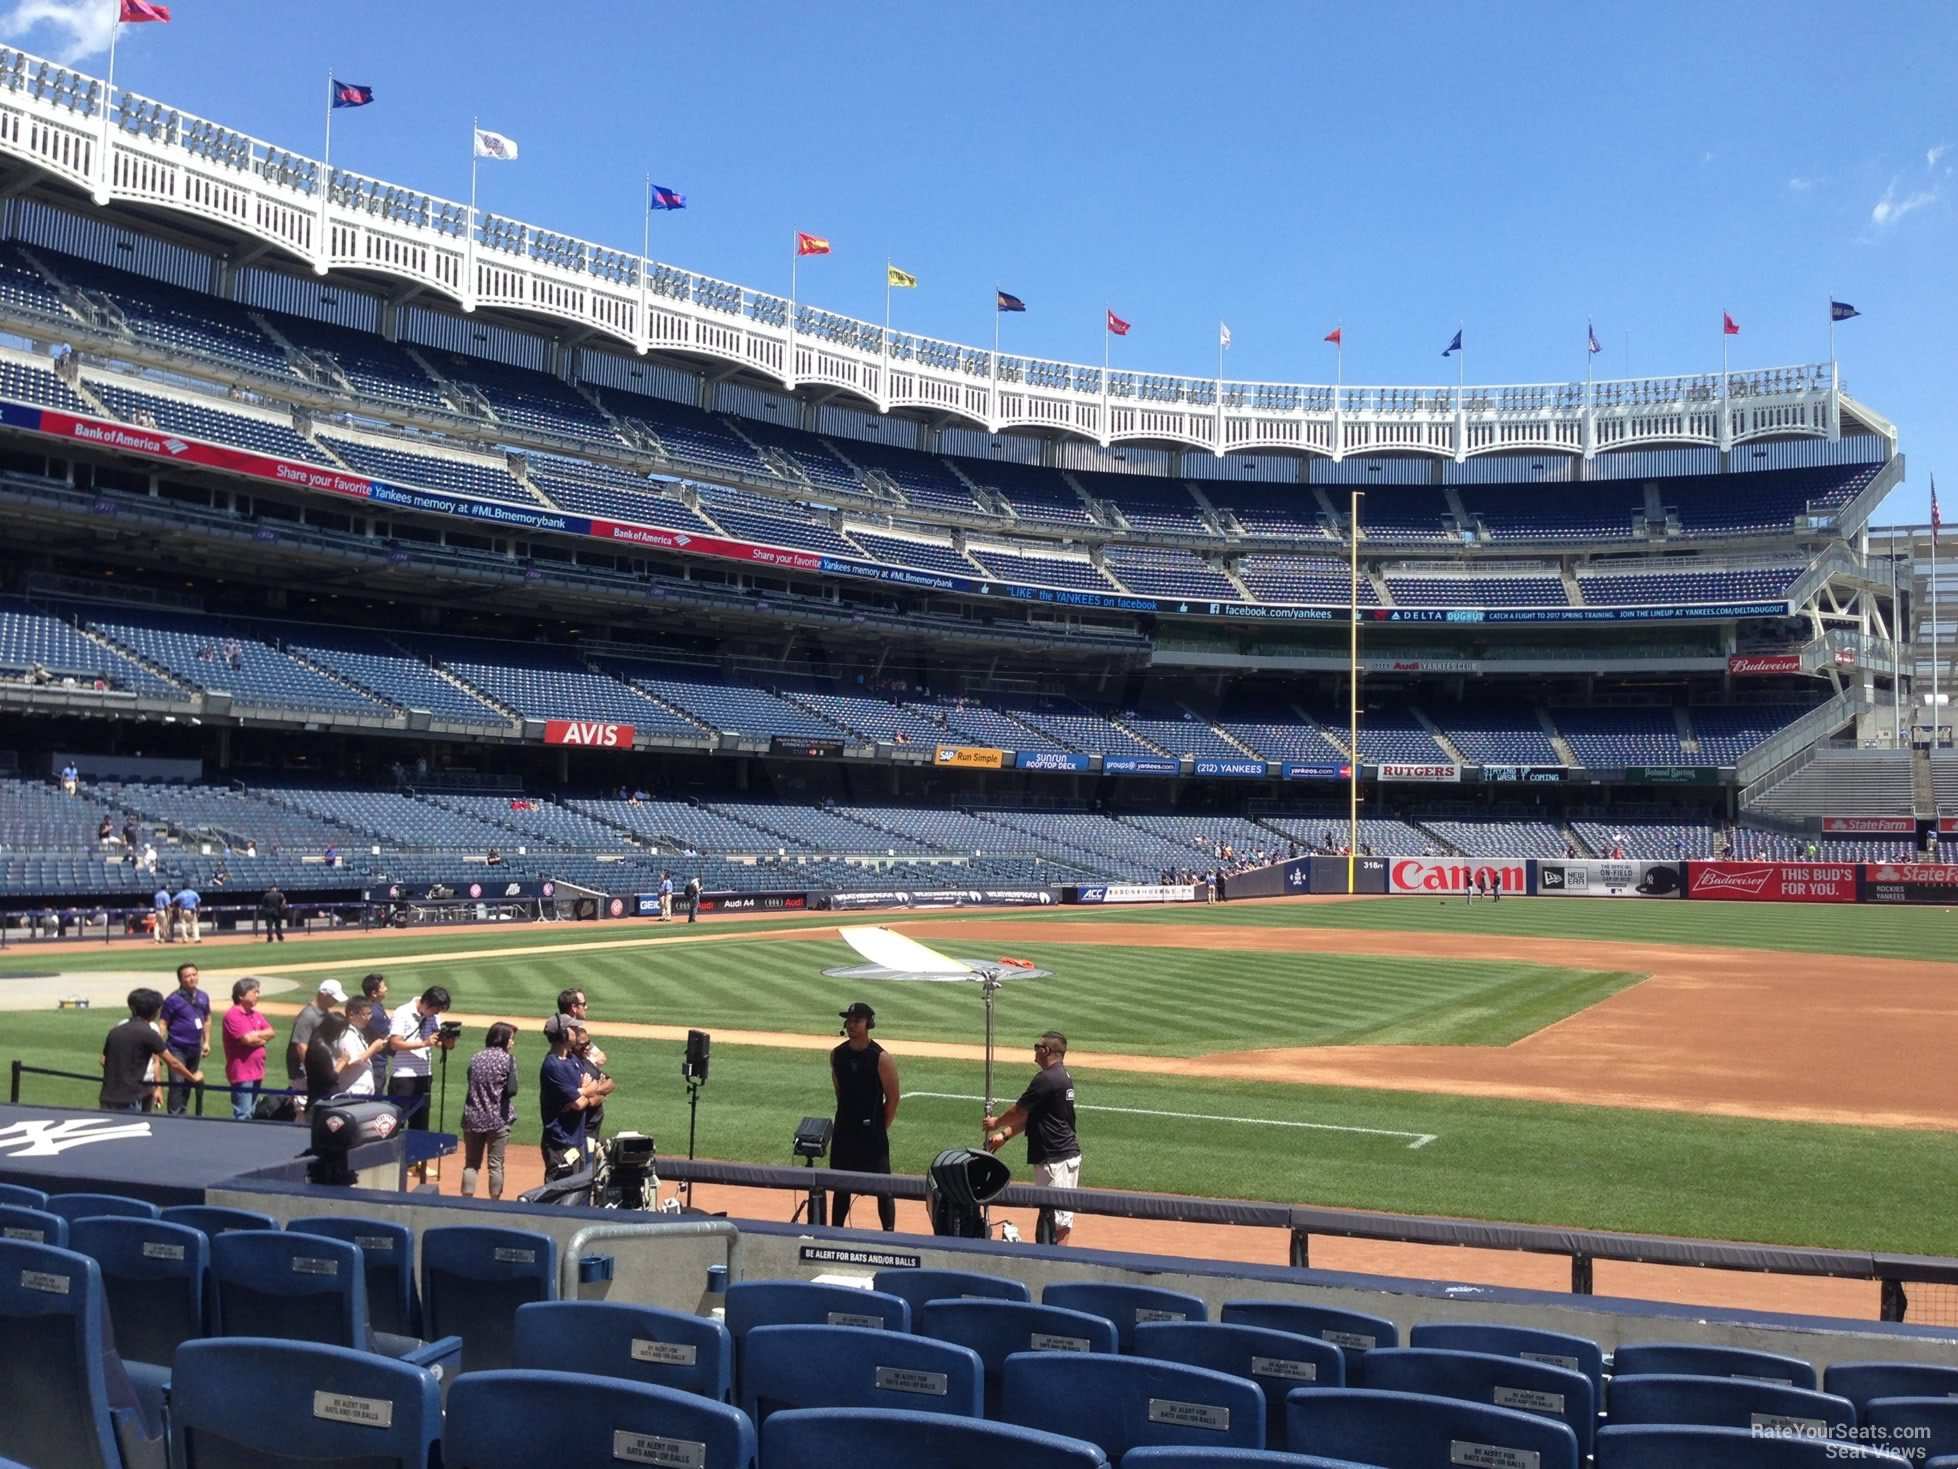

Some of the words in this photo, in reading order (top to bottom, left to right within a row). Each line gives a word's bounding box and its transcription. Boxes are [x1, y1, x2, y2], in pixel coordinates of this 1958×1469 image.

[74, 422, 104, 440] Bank
[104, 431, 116, 442] of
[116, 434, 160, 452] America
[276, 464, 307, 481] Share
[308, 473, 332, 486] your
[335, 477, 372, 496] favorite
[375, 485, 412, 504] Yankees
[414, 497, 455, 513] memory
[458, 503, 468, 514] at
[472, 505, 566, 529] #MLBmemorybank
[614, 528, 633, 540] Bank
[633, 532, 642, 541] of
[642, 532, 672, 545] America
[753, 549, 775, 561] Share
[775, 554, 793, 564] your
[794, 554, 822, 568] favorite
[823, 558, 851, 573] Yankees
[852, 566, 879, 579] memory
[881, 570, 888, 578] at
[890, 571, 953, 588] #MLBmemorybank
[1039, 590, 1052, 601] the
[1056, 593, 1100, 606] YANKEES
[1103, 598, 1114, 607] on
[1117, 597, 1157, 610] facebook
[1225, 604, 1332, 619] facebook.com/yankees
[1404, 611, 1442, 620] DELTA
[1489, 612, 1508, 620] CATCH
[1561, 611, 1583, 619] SPRING
[1585, 611, 1616, 619] TRAINING.
[1619, 610, 1635, 618] JOIN
[1636, 610, 1649, 618] THE
[1650, 609, 1674, 617] LINEUP
[1685, 605, 1784, 616] YANKEES.COM/DELTADUGOUT
[1394, 662, 1419, 670] Audi
[1422, 662, 1456, 670] YANKEES
[1730, 659, 1800, 673] Budweiser
[562, 723, 619, 746] AVIS
[939, 750, 955, 761] SAP
[957, 753, 971, 761] Run
[973, 753, 997, 764] Simple
[1026, 761, 1057, 769] ROOFTOP
[1058, 762, 1076, 770] DECK
[1197, 764, 1218, 774] (212)
[1220, 764, 1262, 774] YANKEES
[1290, 767, 1334, 776] yankees.com
[1383, 766, 1456, 777] RUTGERS
[1483, 767, 1516, 775] STAYING
[1644, 768, 1670, 777] Poland
[1671, 768, 1696, 779] Spring
[1392, 860, 1524, 891] Canon
[1700, 873, 1764, 886] Budweiser
[1781, 868, 1810, 881] THIS
[1814, 869, 1853, 881] BUD'S
[1083, 889, 1103, 898] ACC
[1781, 883, 1806, 895] FOR
[1809, 883, 1840, 895] YOU.
[640, 901, 661, 910] GEIC
[724, 900, 742, 908] Audi
[743, 899, 755, 907] A4
[785, 899, 804, 907] Audi
[805, 1249, 814, 1258] BE
[815, 1250, 835, 1259] ALERT
[836, 1252, 849, 1260] FOR
[850, 1253, 867, 1263] BATS
[868, 1255, 893, 1265] AND/OR
[895, 1257, 916, 1267] BALLS
[637, 1440, 645, 1448] BE
[647, 1441, 665, 1450] ALERT
[667, 1444, 679, 1453] FOR
[627, 1446, 642, 1455] BATS
[670, 1454, 689, 1464] BALLS
